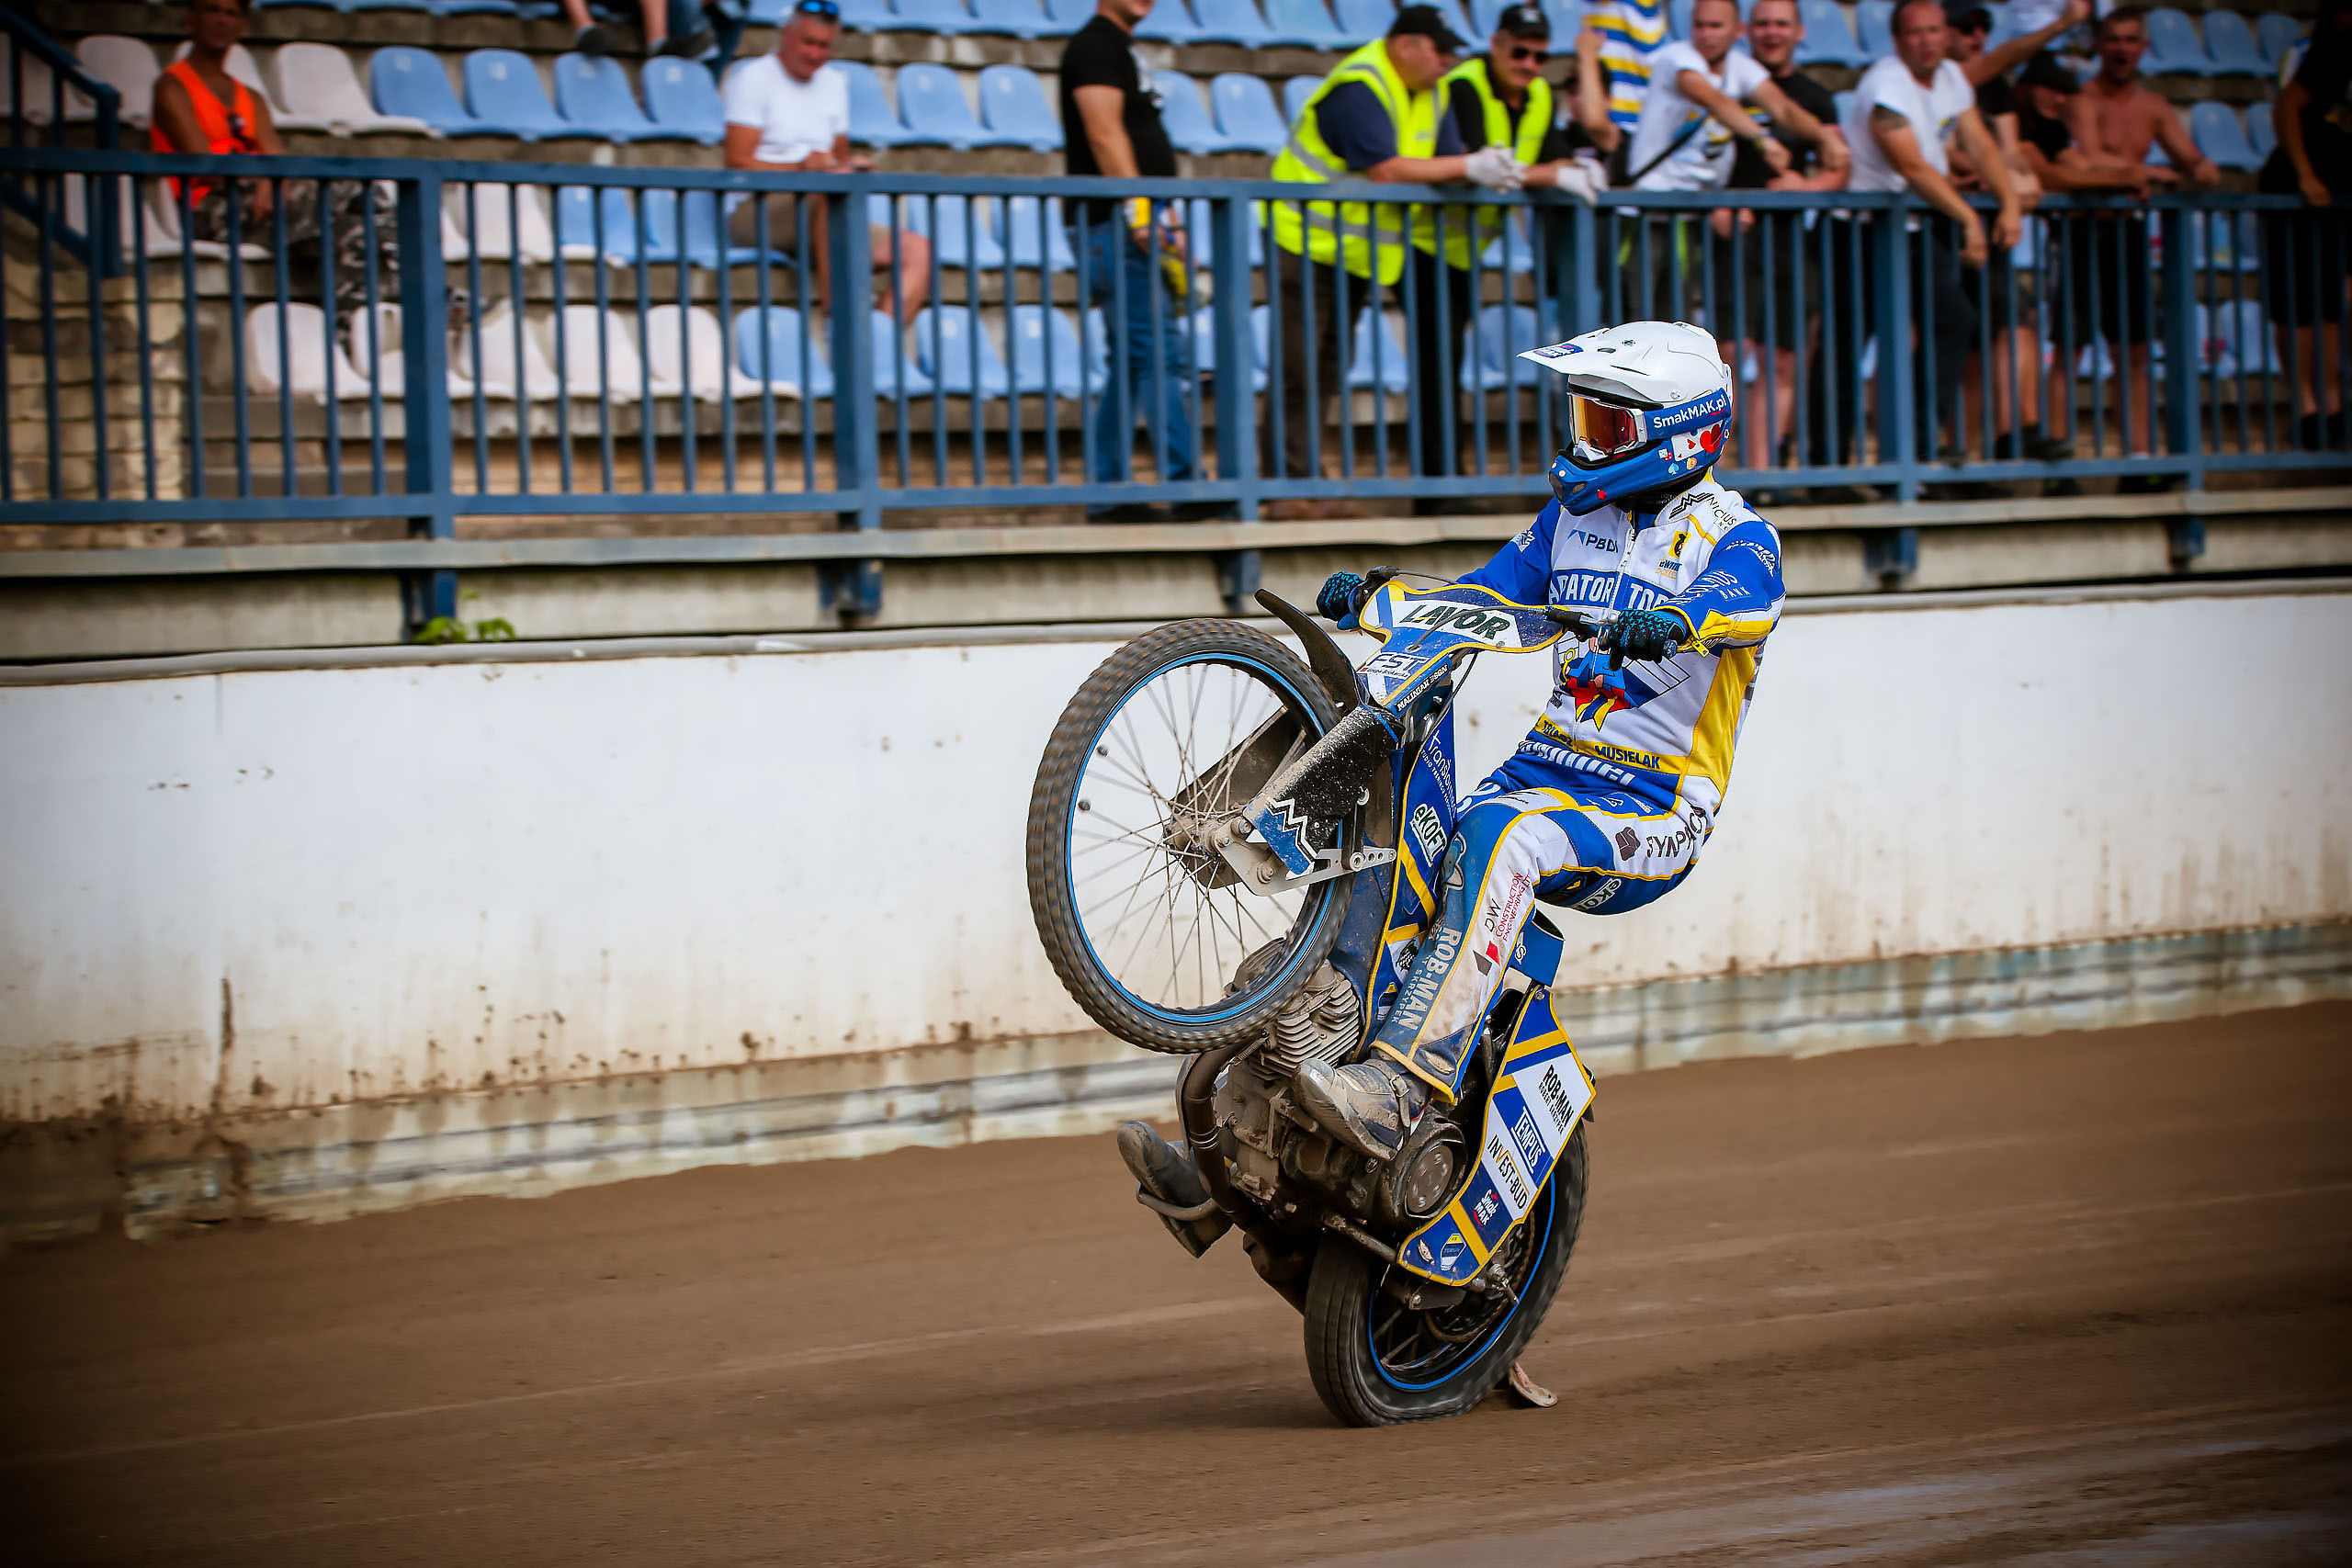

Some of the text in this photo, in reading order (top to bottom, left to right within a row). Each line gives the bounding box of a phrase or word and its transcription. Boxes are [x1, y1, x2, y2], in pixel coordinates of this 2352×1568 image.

[1654, 393, 1727, 429] SmakMAK.pl
[1719, 586, 1751, 601] BANK
[1399, 604, 1510, 640] LAVOR
[1366, 653, 1428, 671] FST
[1594, 745, 1661, 770] MUSIELAK
[1485, 897, 1502, 932] DW
[1495, 873, 1523, 938] CONSTRUCTION
[1398, 927, 1463, 1031] ROB-MAN
[1514, 1111, 1543, 1168] TEMPUS
[1487, 1134, 1529, 1210] INVEST-BUD
